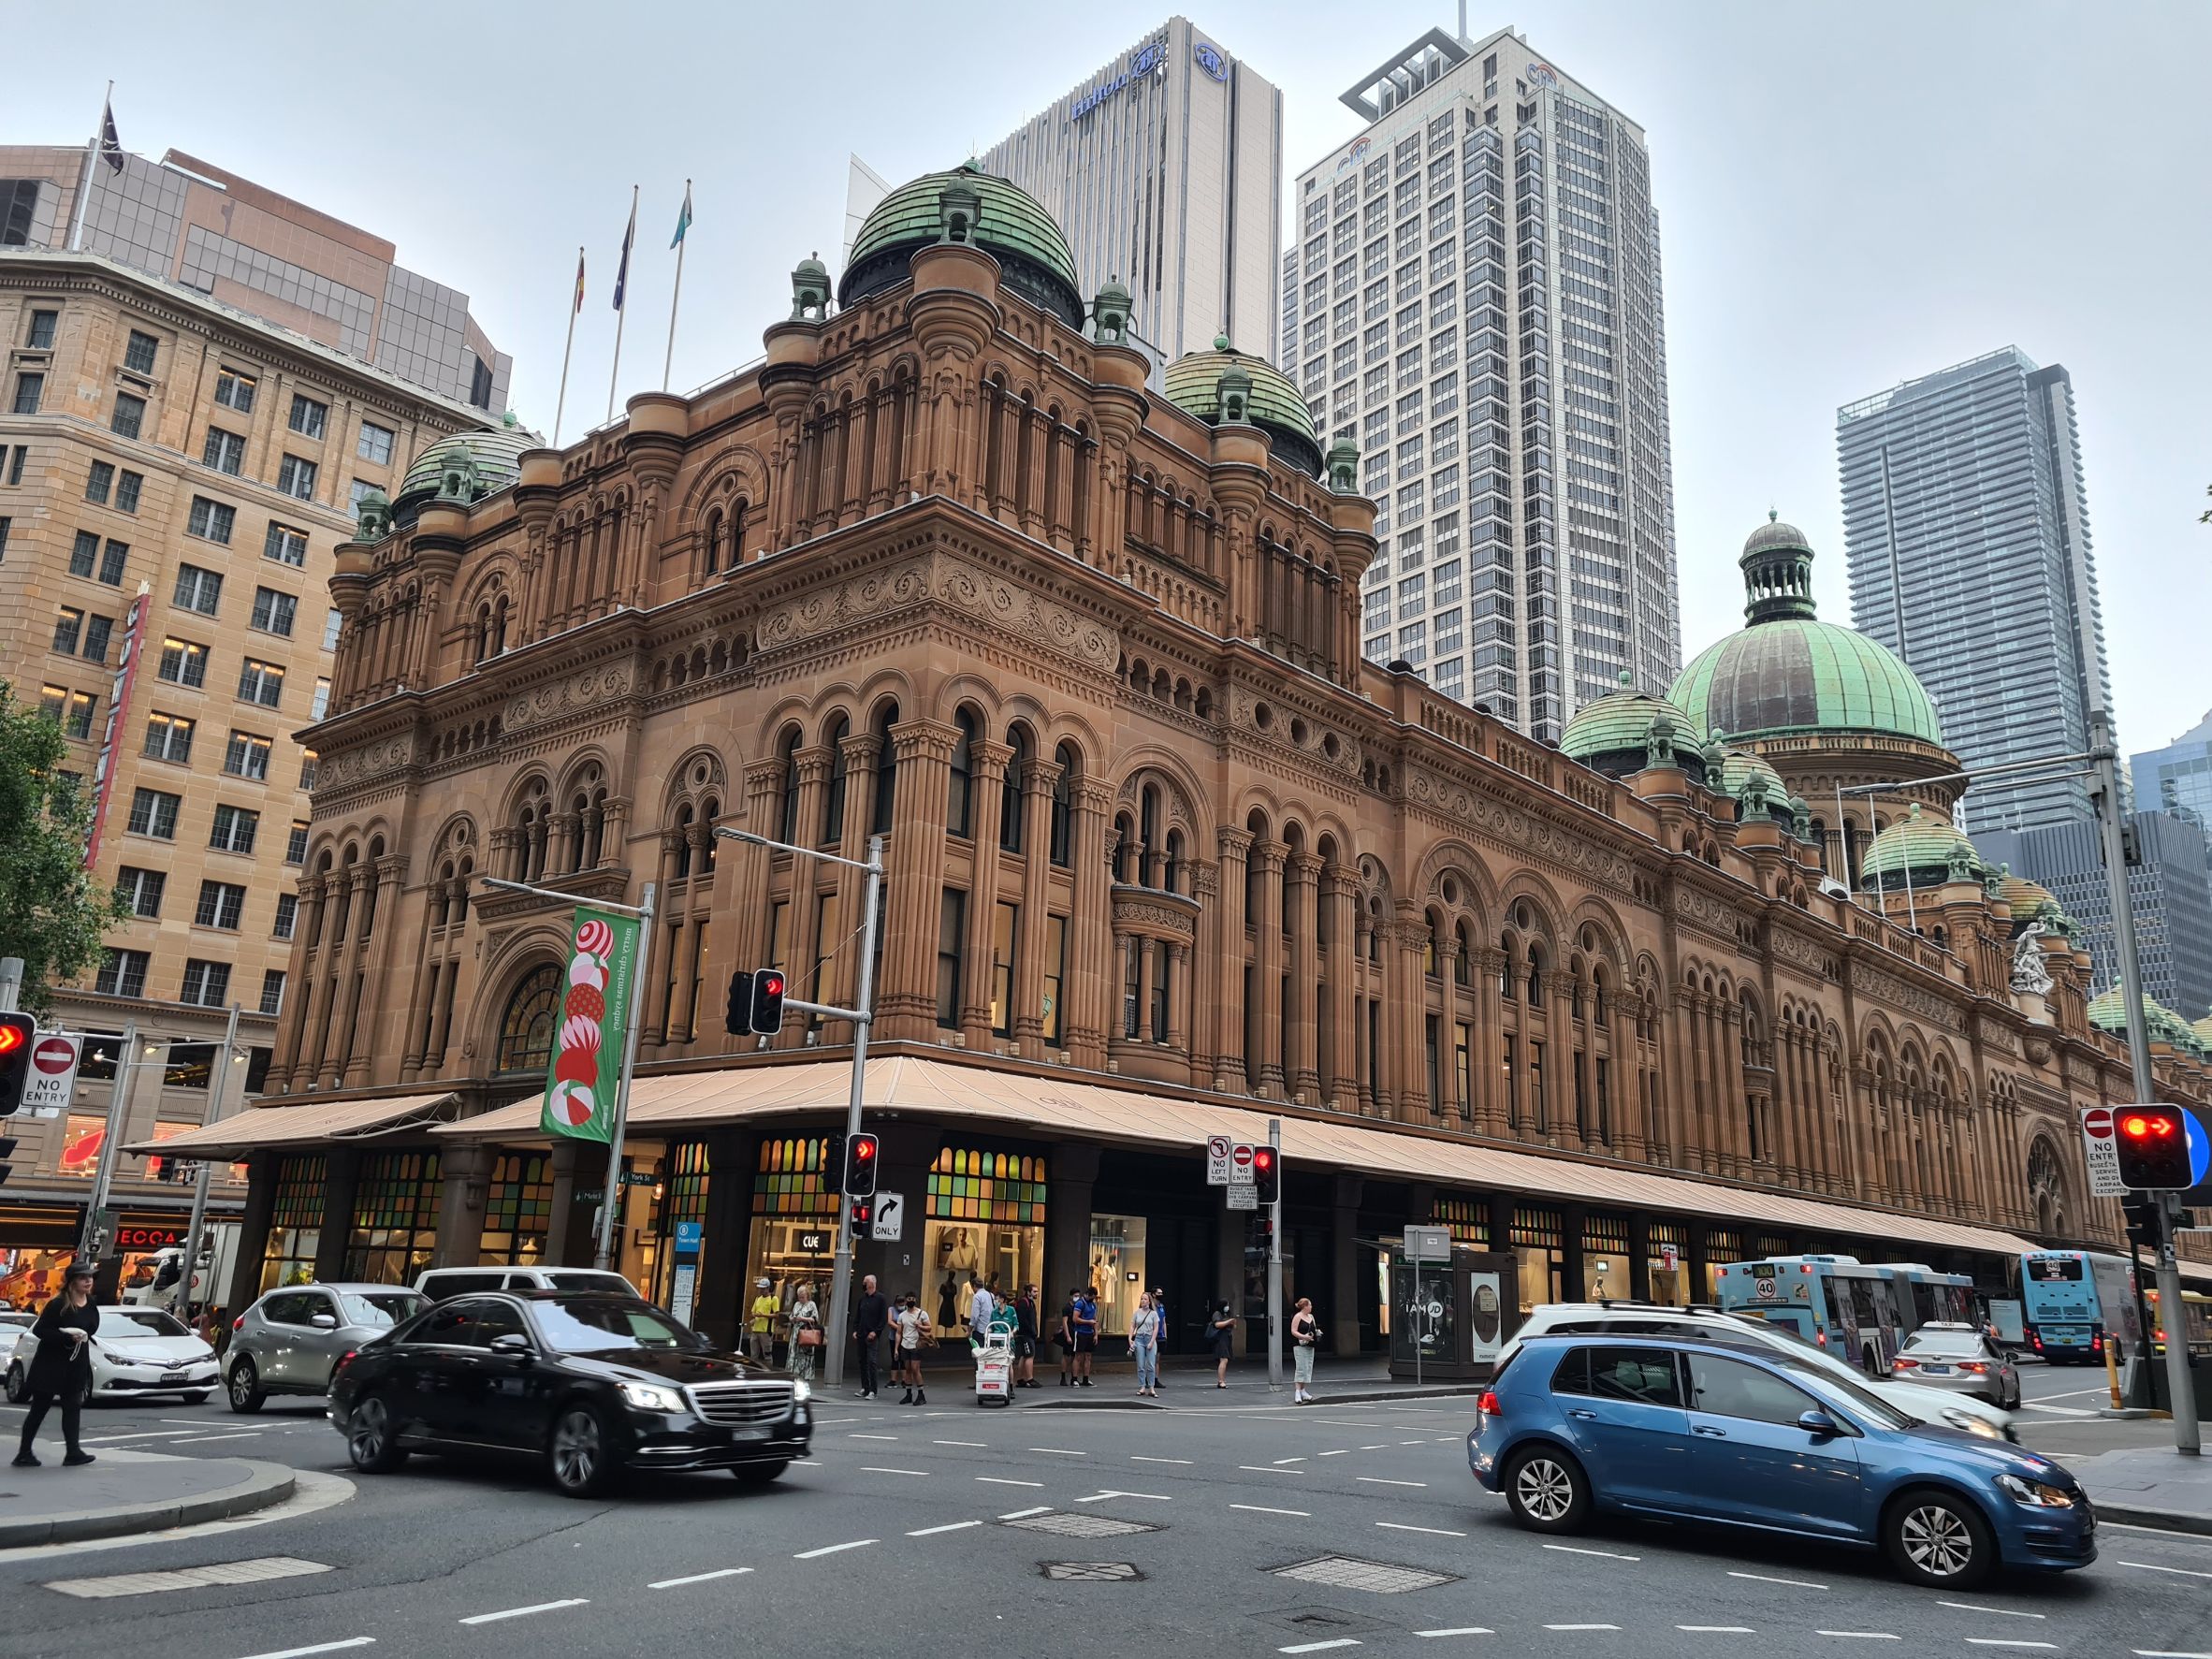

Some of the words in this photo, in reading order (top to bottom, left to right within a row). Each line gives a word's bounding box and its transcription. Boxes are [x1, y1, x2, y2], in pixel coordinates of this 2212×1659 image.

[1071, 73, 1128, 121] Hilton
[37, 1079, 60, 1091] NO
[26, 1091, 67, 1102] ENTRY
[2094, 1142, 2112, 1152] NO
[1213, 1159, 1226, 1168] NO
[875, 1226, 899, 1236] ONLY
[803, 1235, 820, 1248] CUE
[1759, 1283, 1773, 1293] 40
[1430, 1305, 1441, 1314] JD
